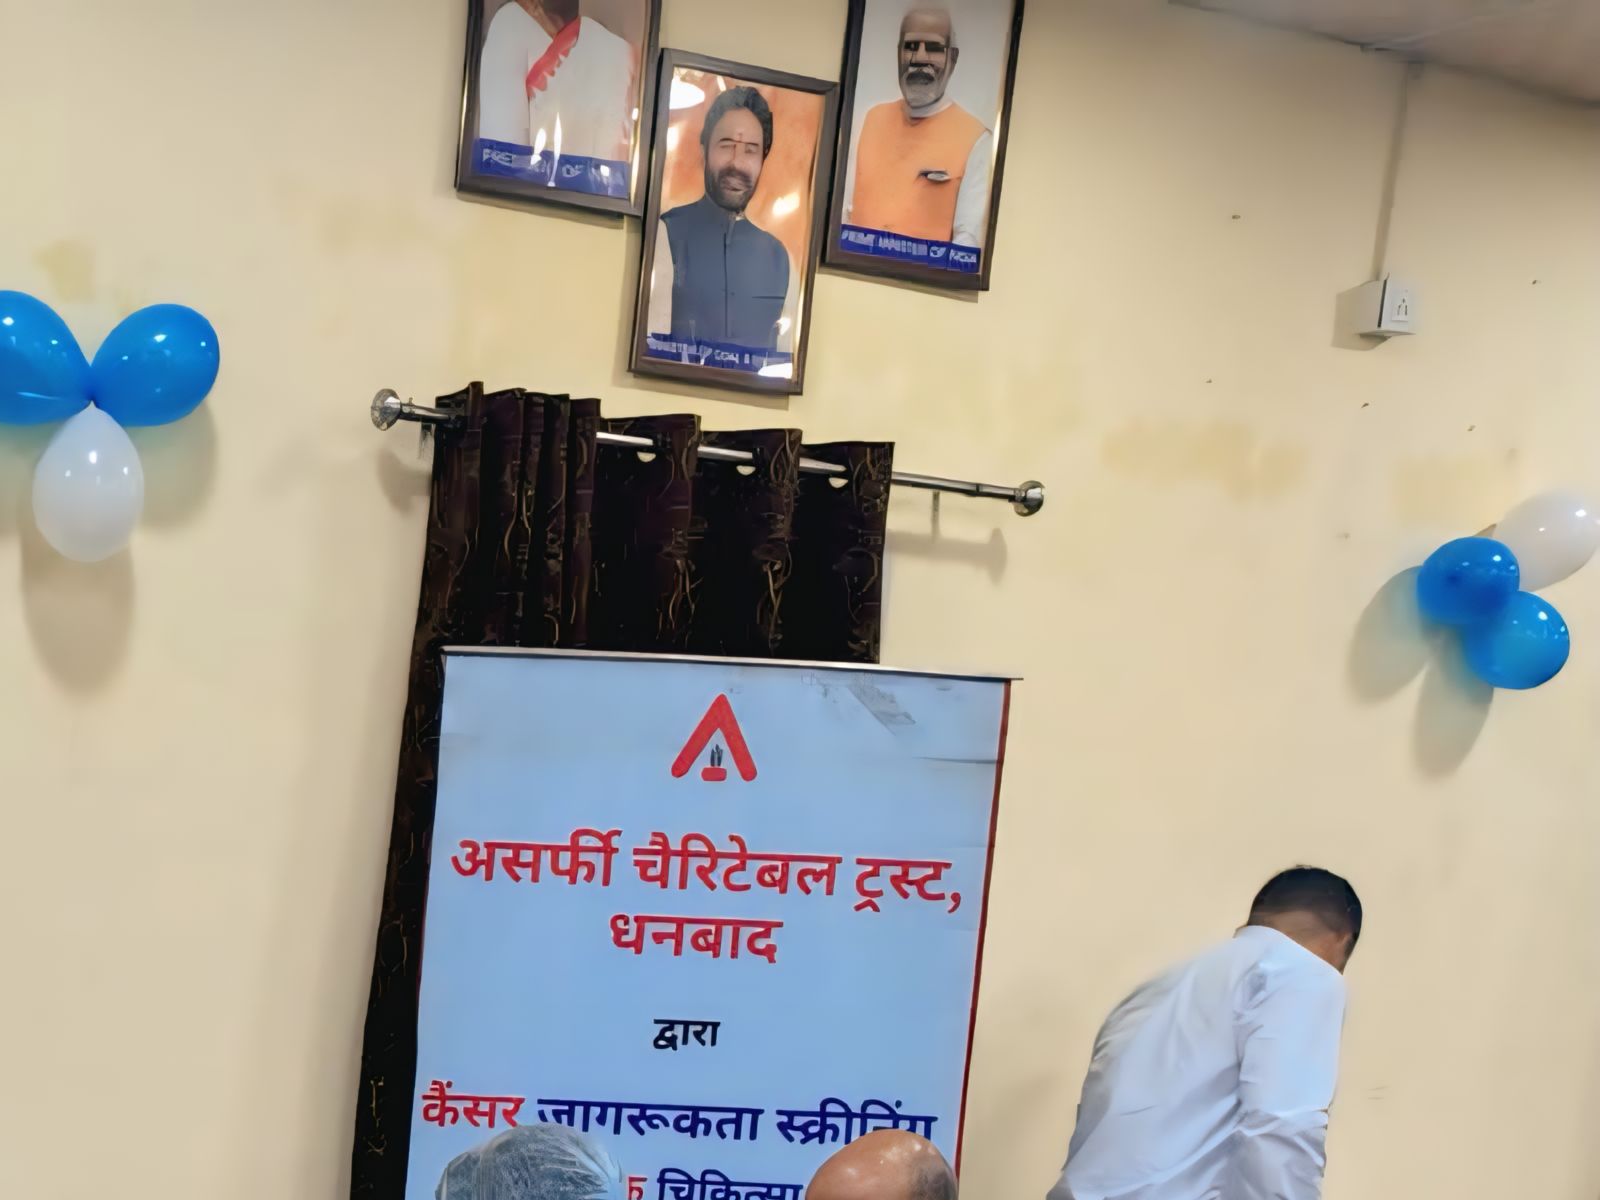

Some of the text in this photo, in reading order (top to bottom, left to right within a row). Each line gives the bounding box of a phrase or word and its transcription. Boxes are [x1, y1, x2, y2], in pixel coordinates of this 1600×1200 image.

[451, 828, 960, 912] असर्फी चैरिटेबल ट्रस्ट,
[610, 914, 782, 962] धनबाद
[654, 1020, 720, 1050] द्वारा
[422, 1081, 523, 1127] कैंसर
